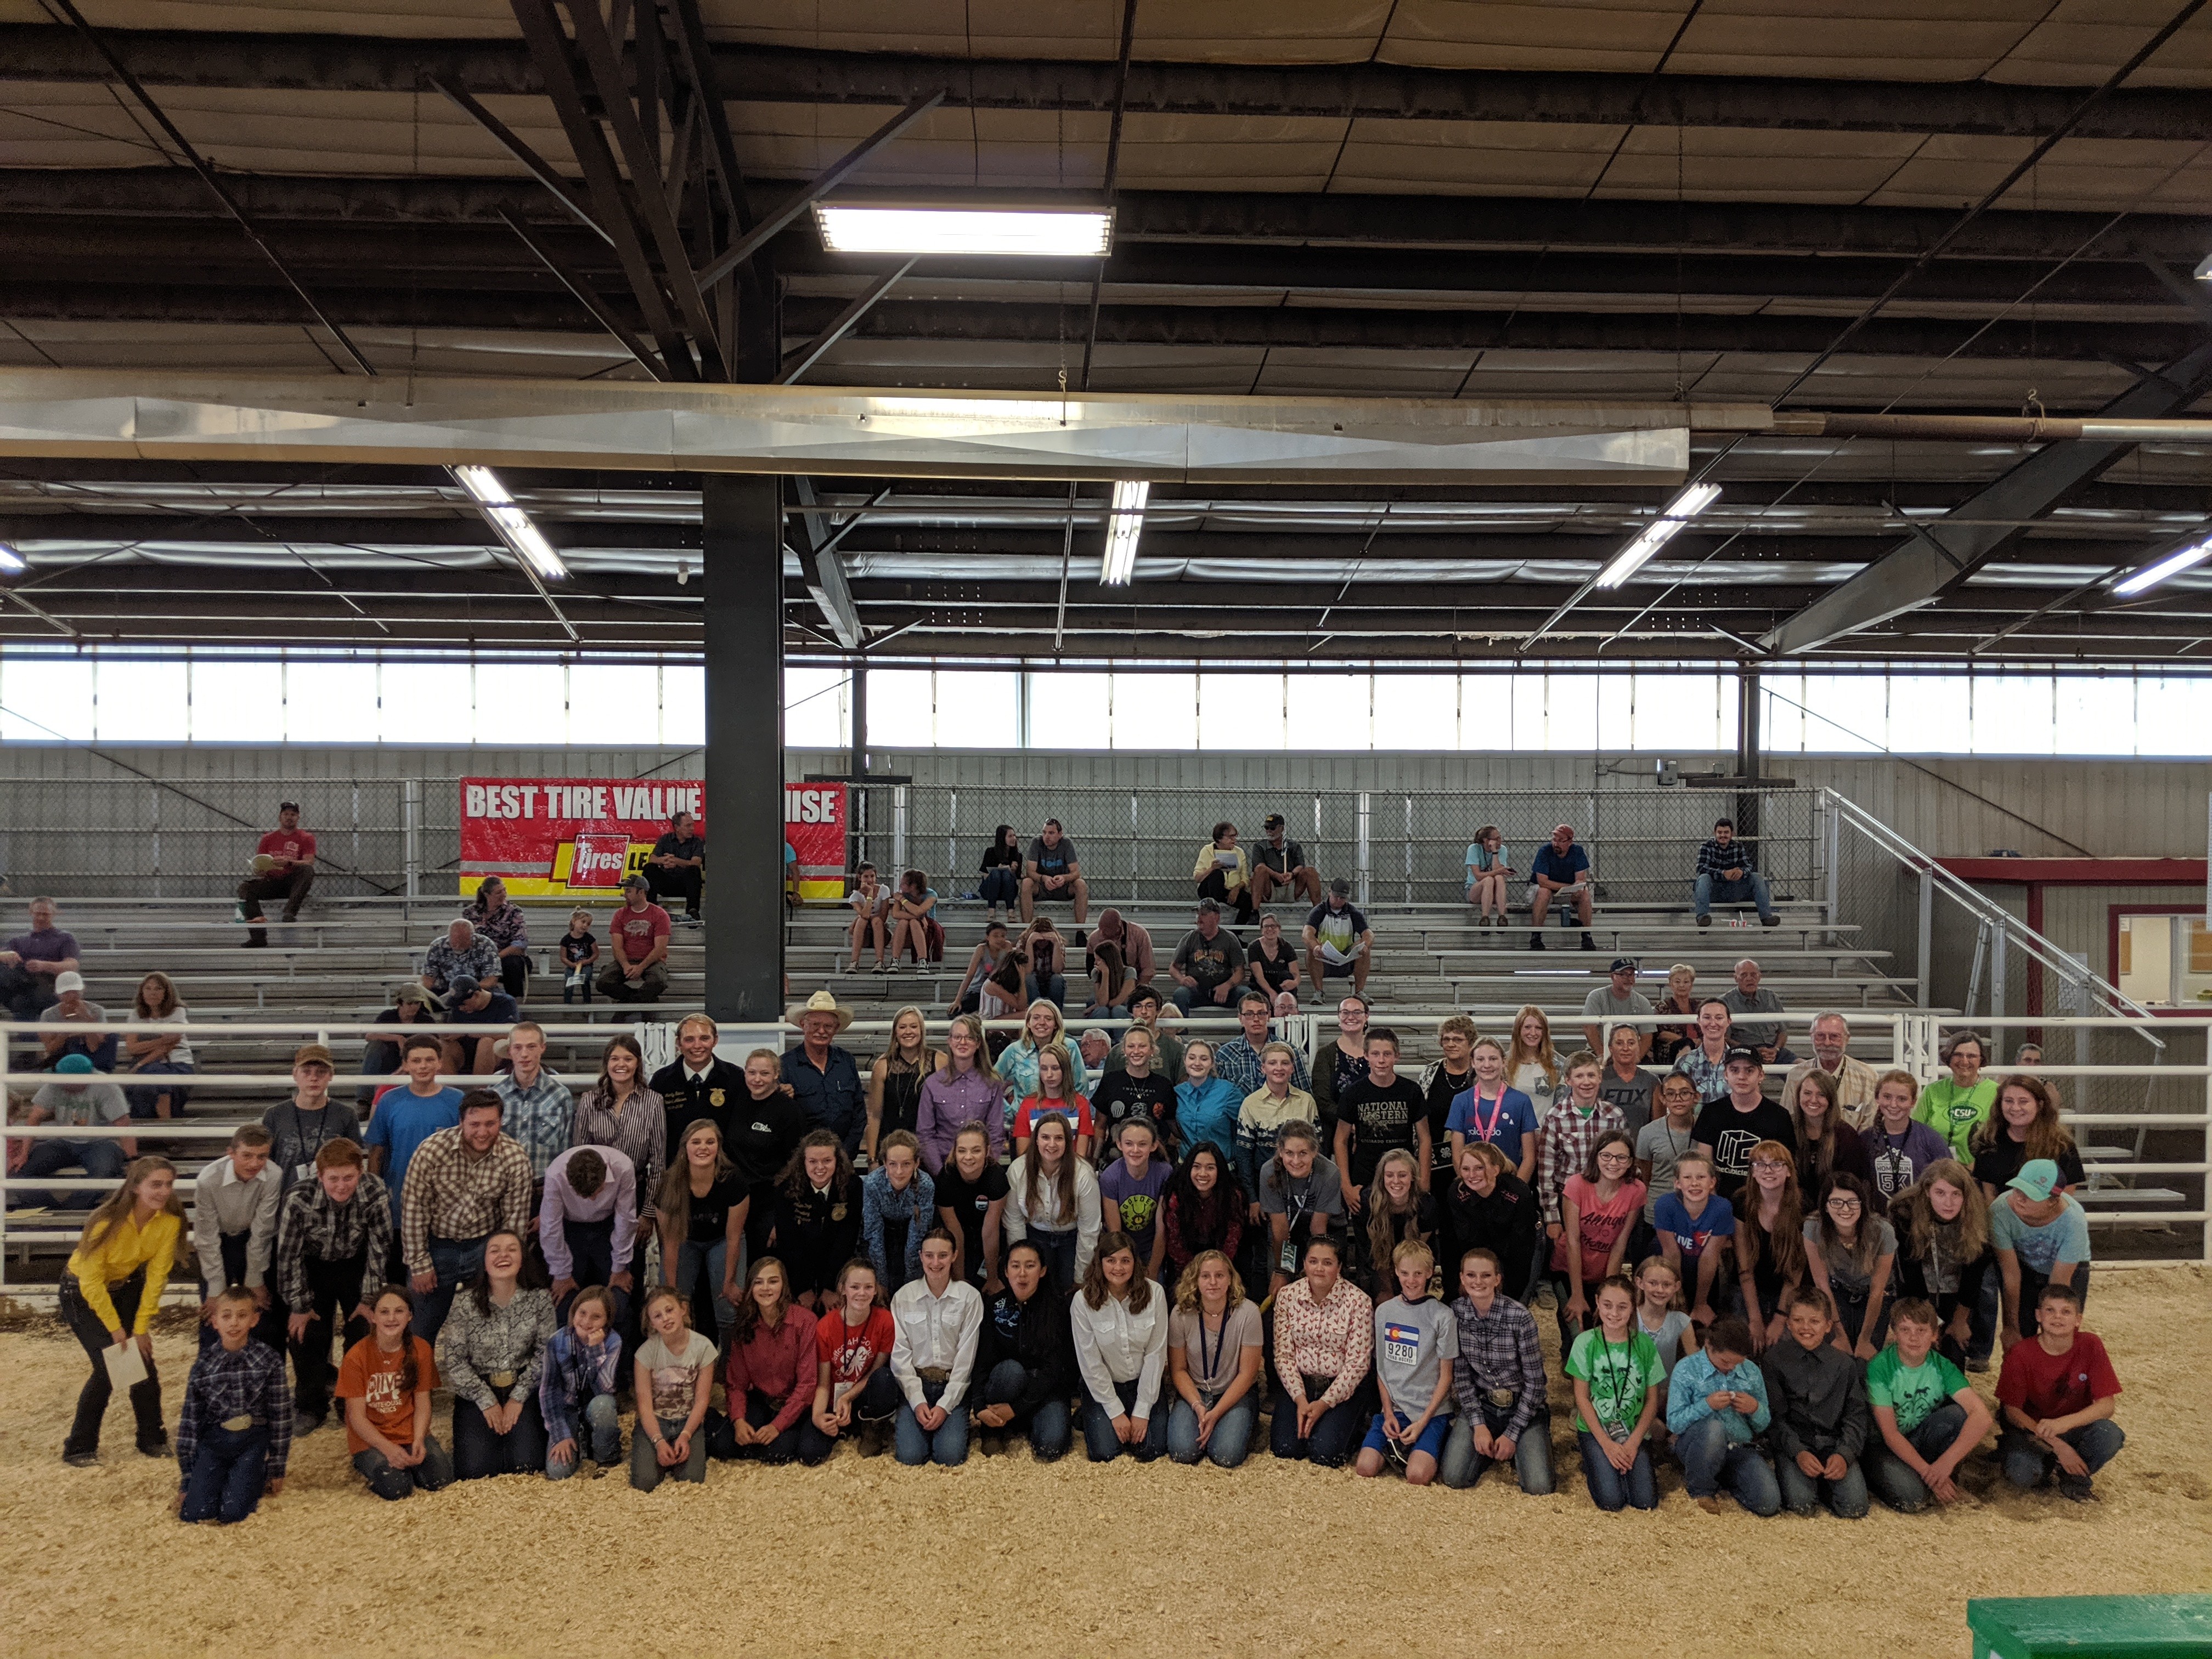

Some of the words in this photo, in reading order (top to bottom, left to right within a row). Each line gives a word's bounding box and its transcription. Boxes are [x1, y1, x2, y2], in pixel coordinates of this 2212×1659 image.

[467, 785, 538, 819] BEST
[544, 786, 607, 819] TIRE
[613, 787, 702, 820] VALUE
[785, 790, 835, 823] ISE
[577, 843, 623, 873] Tires
[628, 852, 648, 871] LE
[1604, 1088, 1647, 1105] FOX
[1358, 1101, 1408, 1113] NATIONAL
[1954, 1109, 1971, 1117] CSU
[1359, 1110, 1408, 1121] WSTERN
[1675, 1233, 1694, 1250] IVE
[847, 1336, 859, 1346] 4H
[1388, 1343, 1413, 1359] 9280
